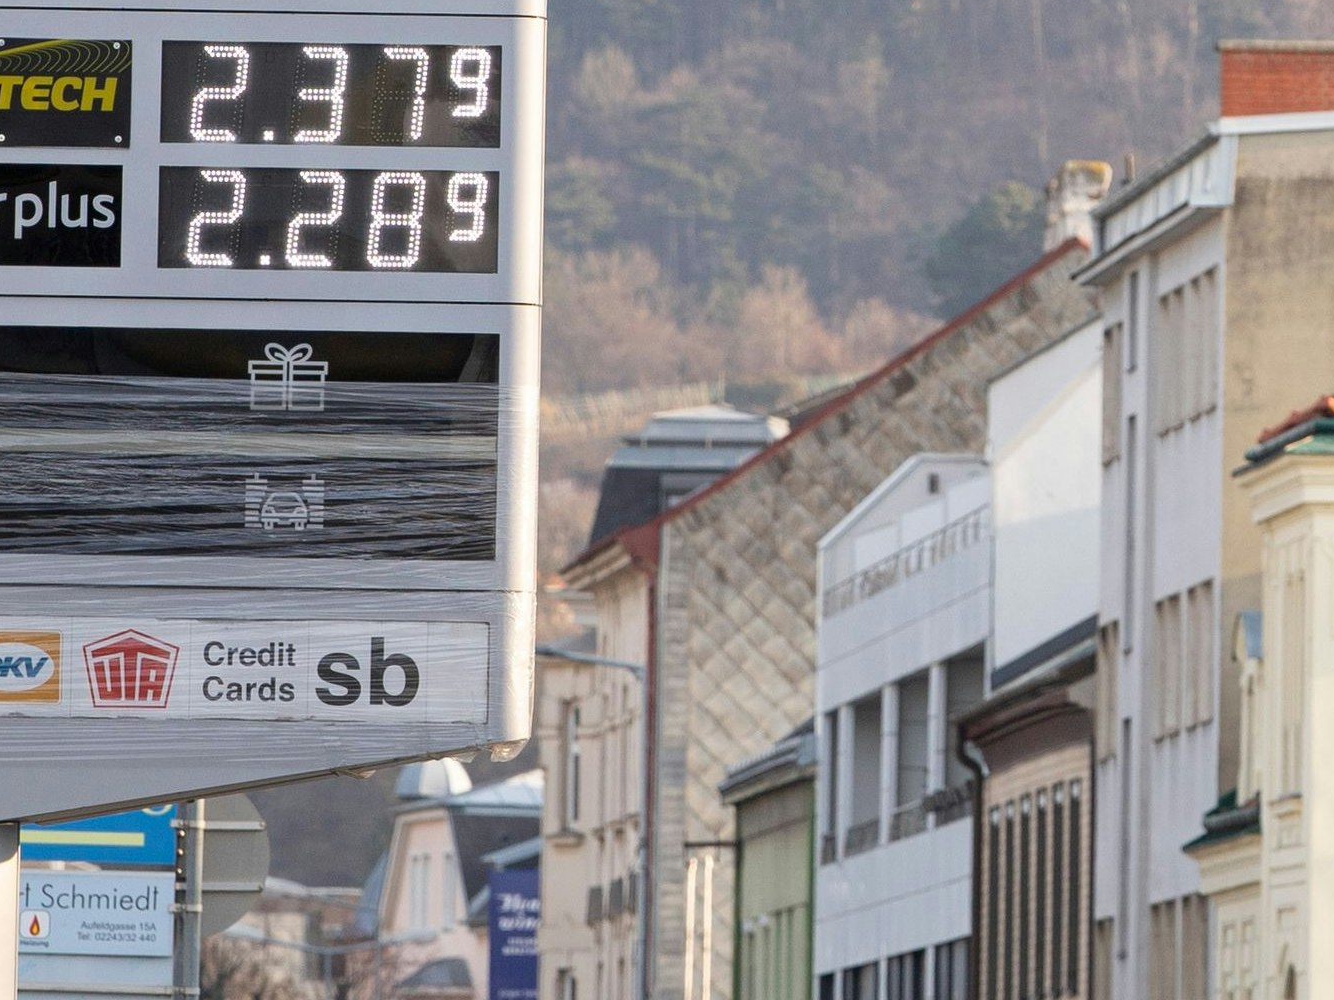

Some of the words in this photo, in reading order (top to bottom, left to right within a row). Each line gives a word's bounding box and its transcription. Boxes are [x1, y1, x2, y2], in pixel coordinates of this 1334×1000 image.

[188, 45, 492, 142] 2.379
[185, 169, 490, 268] 2.289
[202, 639, 297, 668] Credit
[89, 642, 172, 702] UTA
[315, 637, 421, 708] sb
[202, 676, 297, 703] Cards
[41, 883, 159, 911] Schmiedt
[80, 920, 137, 933] Aufeldgasse
[140, 921, 157, 931] 15A
[138, 933, 157, 942] 440
